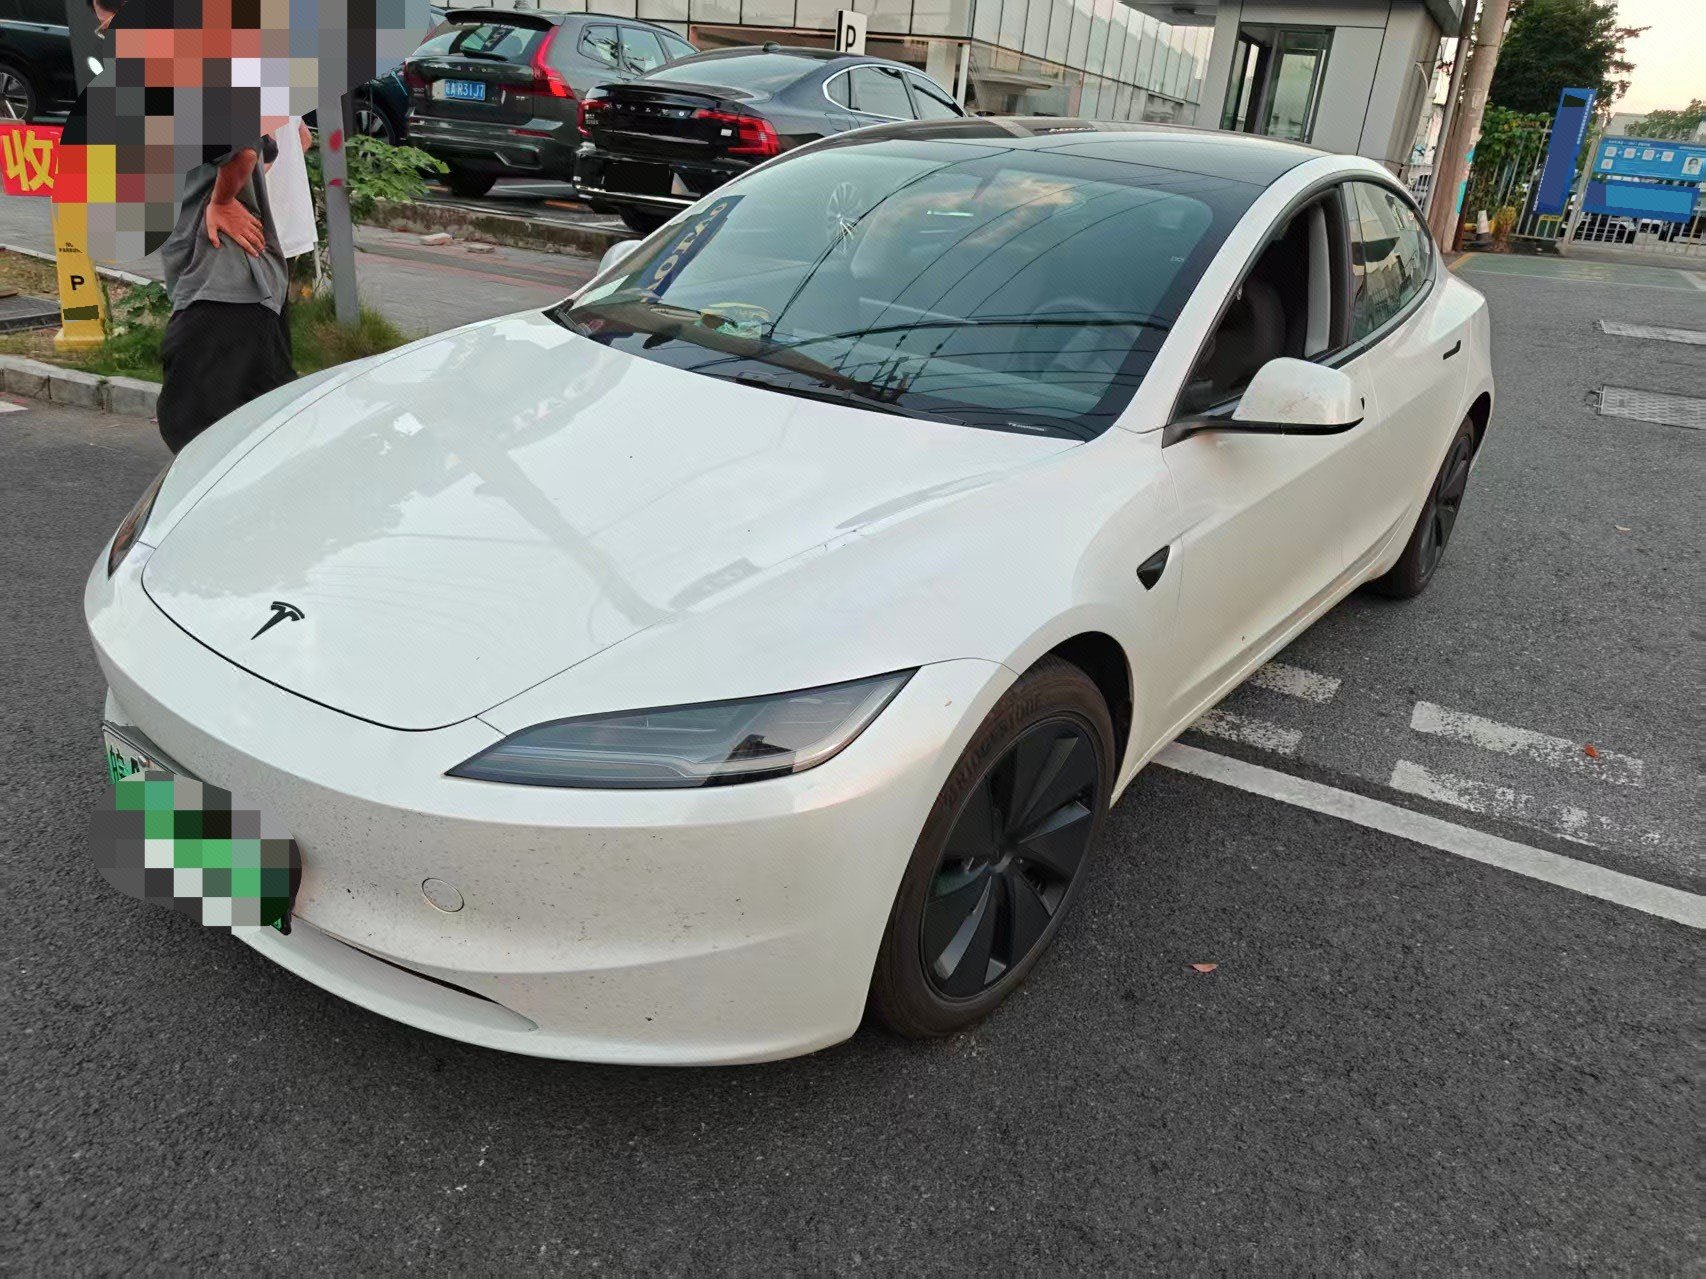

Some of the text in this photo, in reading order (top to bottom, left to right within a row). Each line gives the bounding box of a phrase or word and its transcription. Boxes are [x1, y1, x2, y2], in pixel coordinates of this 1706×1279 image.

[845, 24, 856, 52] P
[2, 129, 58, 192] 收
[70, 275, 85, 291] P
